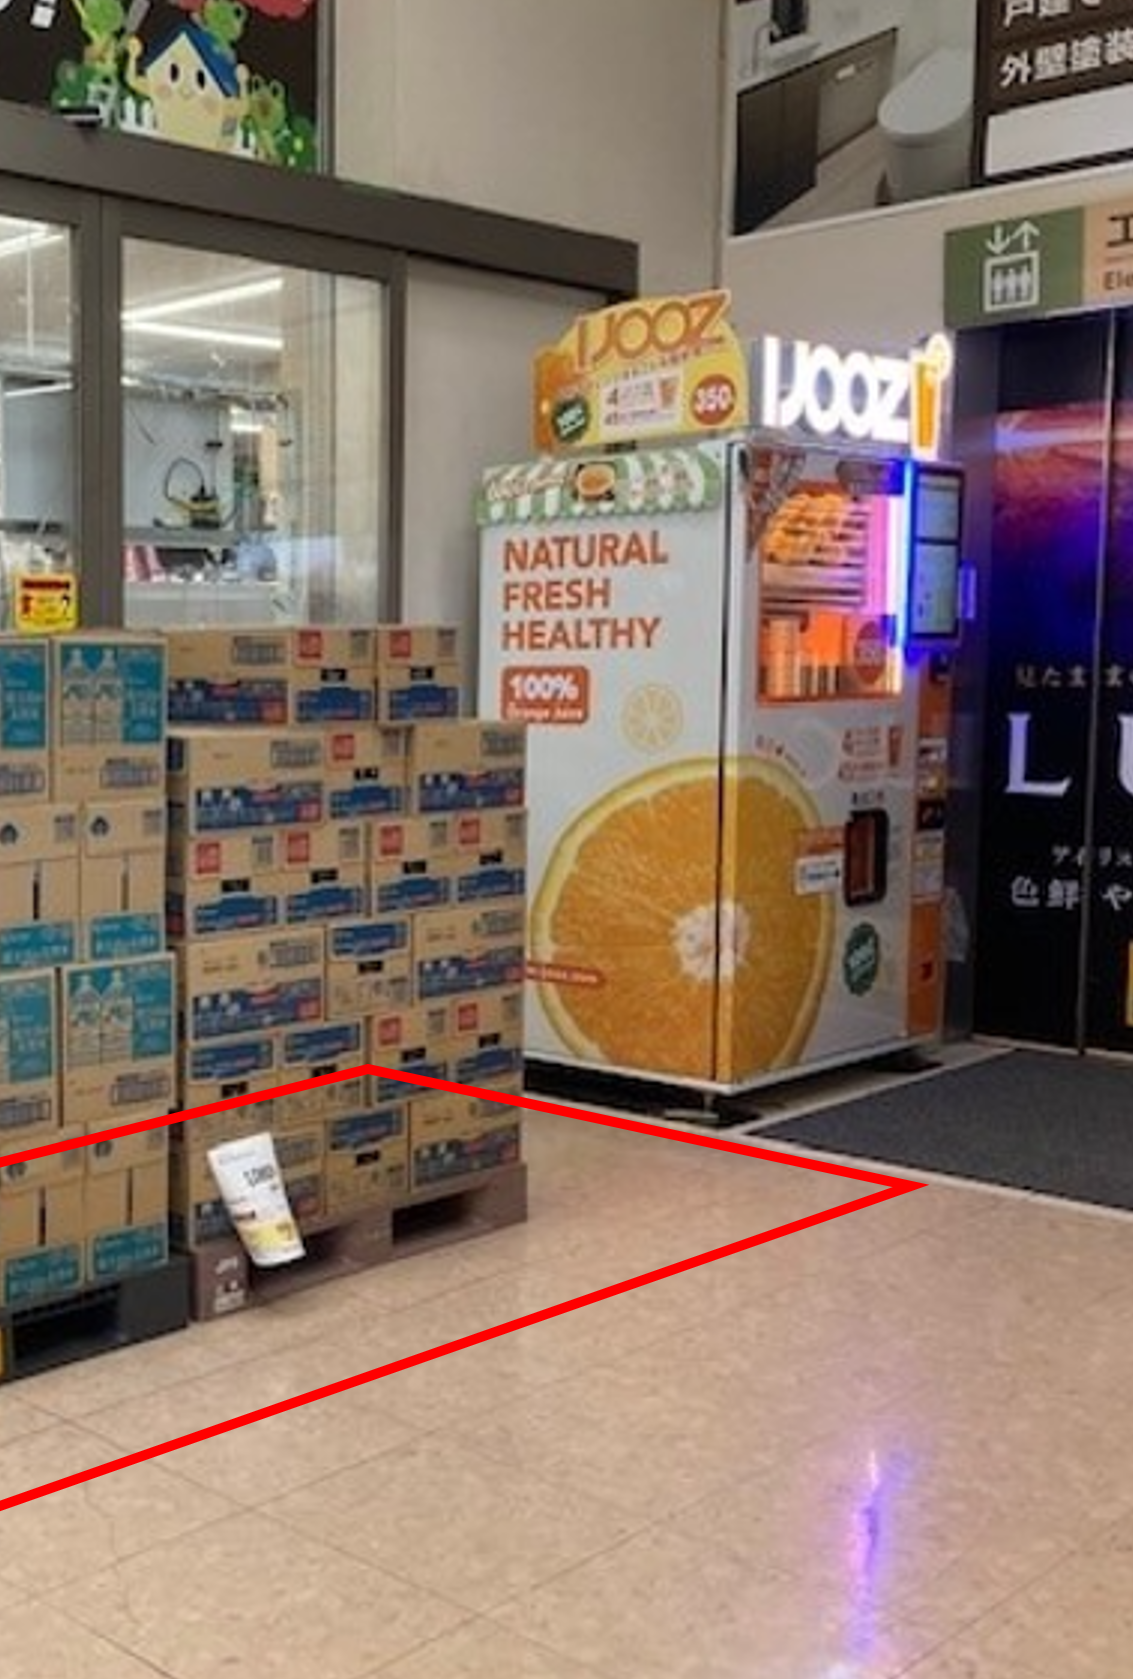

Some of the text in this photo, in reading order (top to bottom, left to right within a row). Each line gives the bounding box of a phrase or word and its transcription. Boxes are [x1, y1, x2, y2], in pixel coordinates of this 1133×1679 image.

[999, 26, 1133, 88] 外壁塗装
[503, 530, 669, 571] NATURAL
[503, 578, 611, 611] FRESH
[501, 617, 661, 651] HEALTHY
[509, 674, 579, 702] 100%
